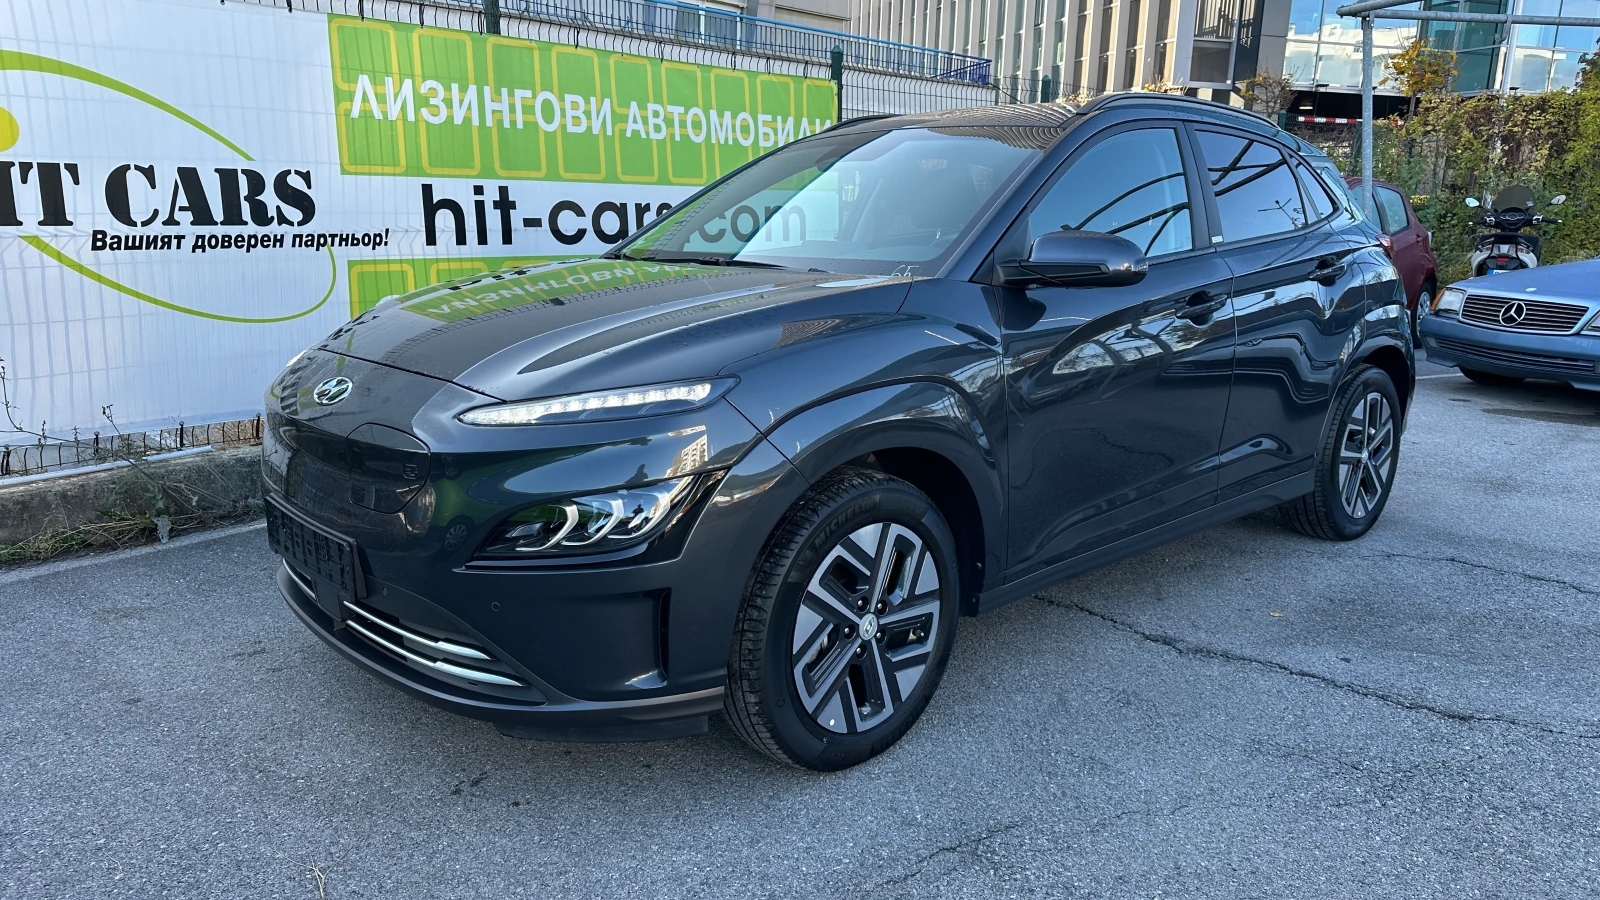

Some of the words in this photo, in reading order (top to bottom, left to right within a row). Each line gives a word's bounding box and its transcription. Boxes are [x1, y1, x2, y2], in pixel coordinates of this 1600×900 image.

[350, 74, 612, 136] ЛИЗИНГОВИ
[105, 164, 316, 228] CARS
[91, 229, 186, 251] Вашият
[191, 233, 285, 253] доверен
[290, 229, 390, 251] партньор!
[814, 497, 880, 550] MICHELIN
